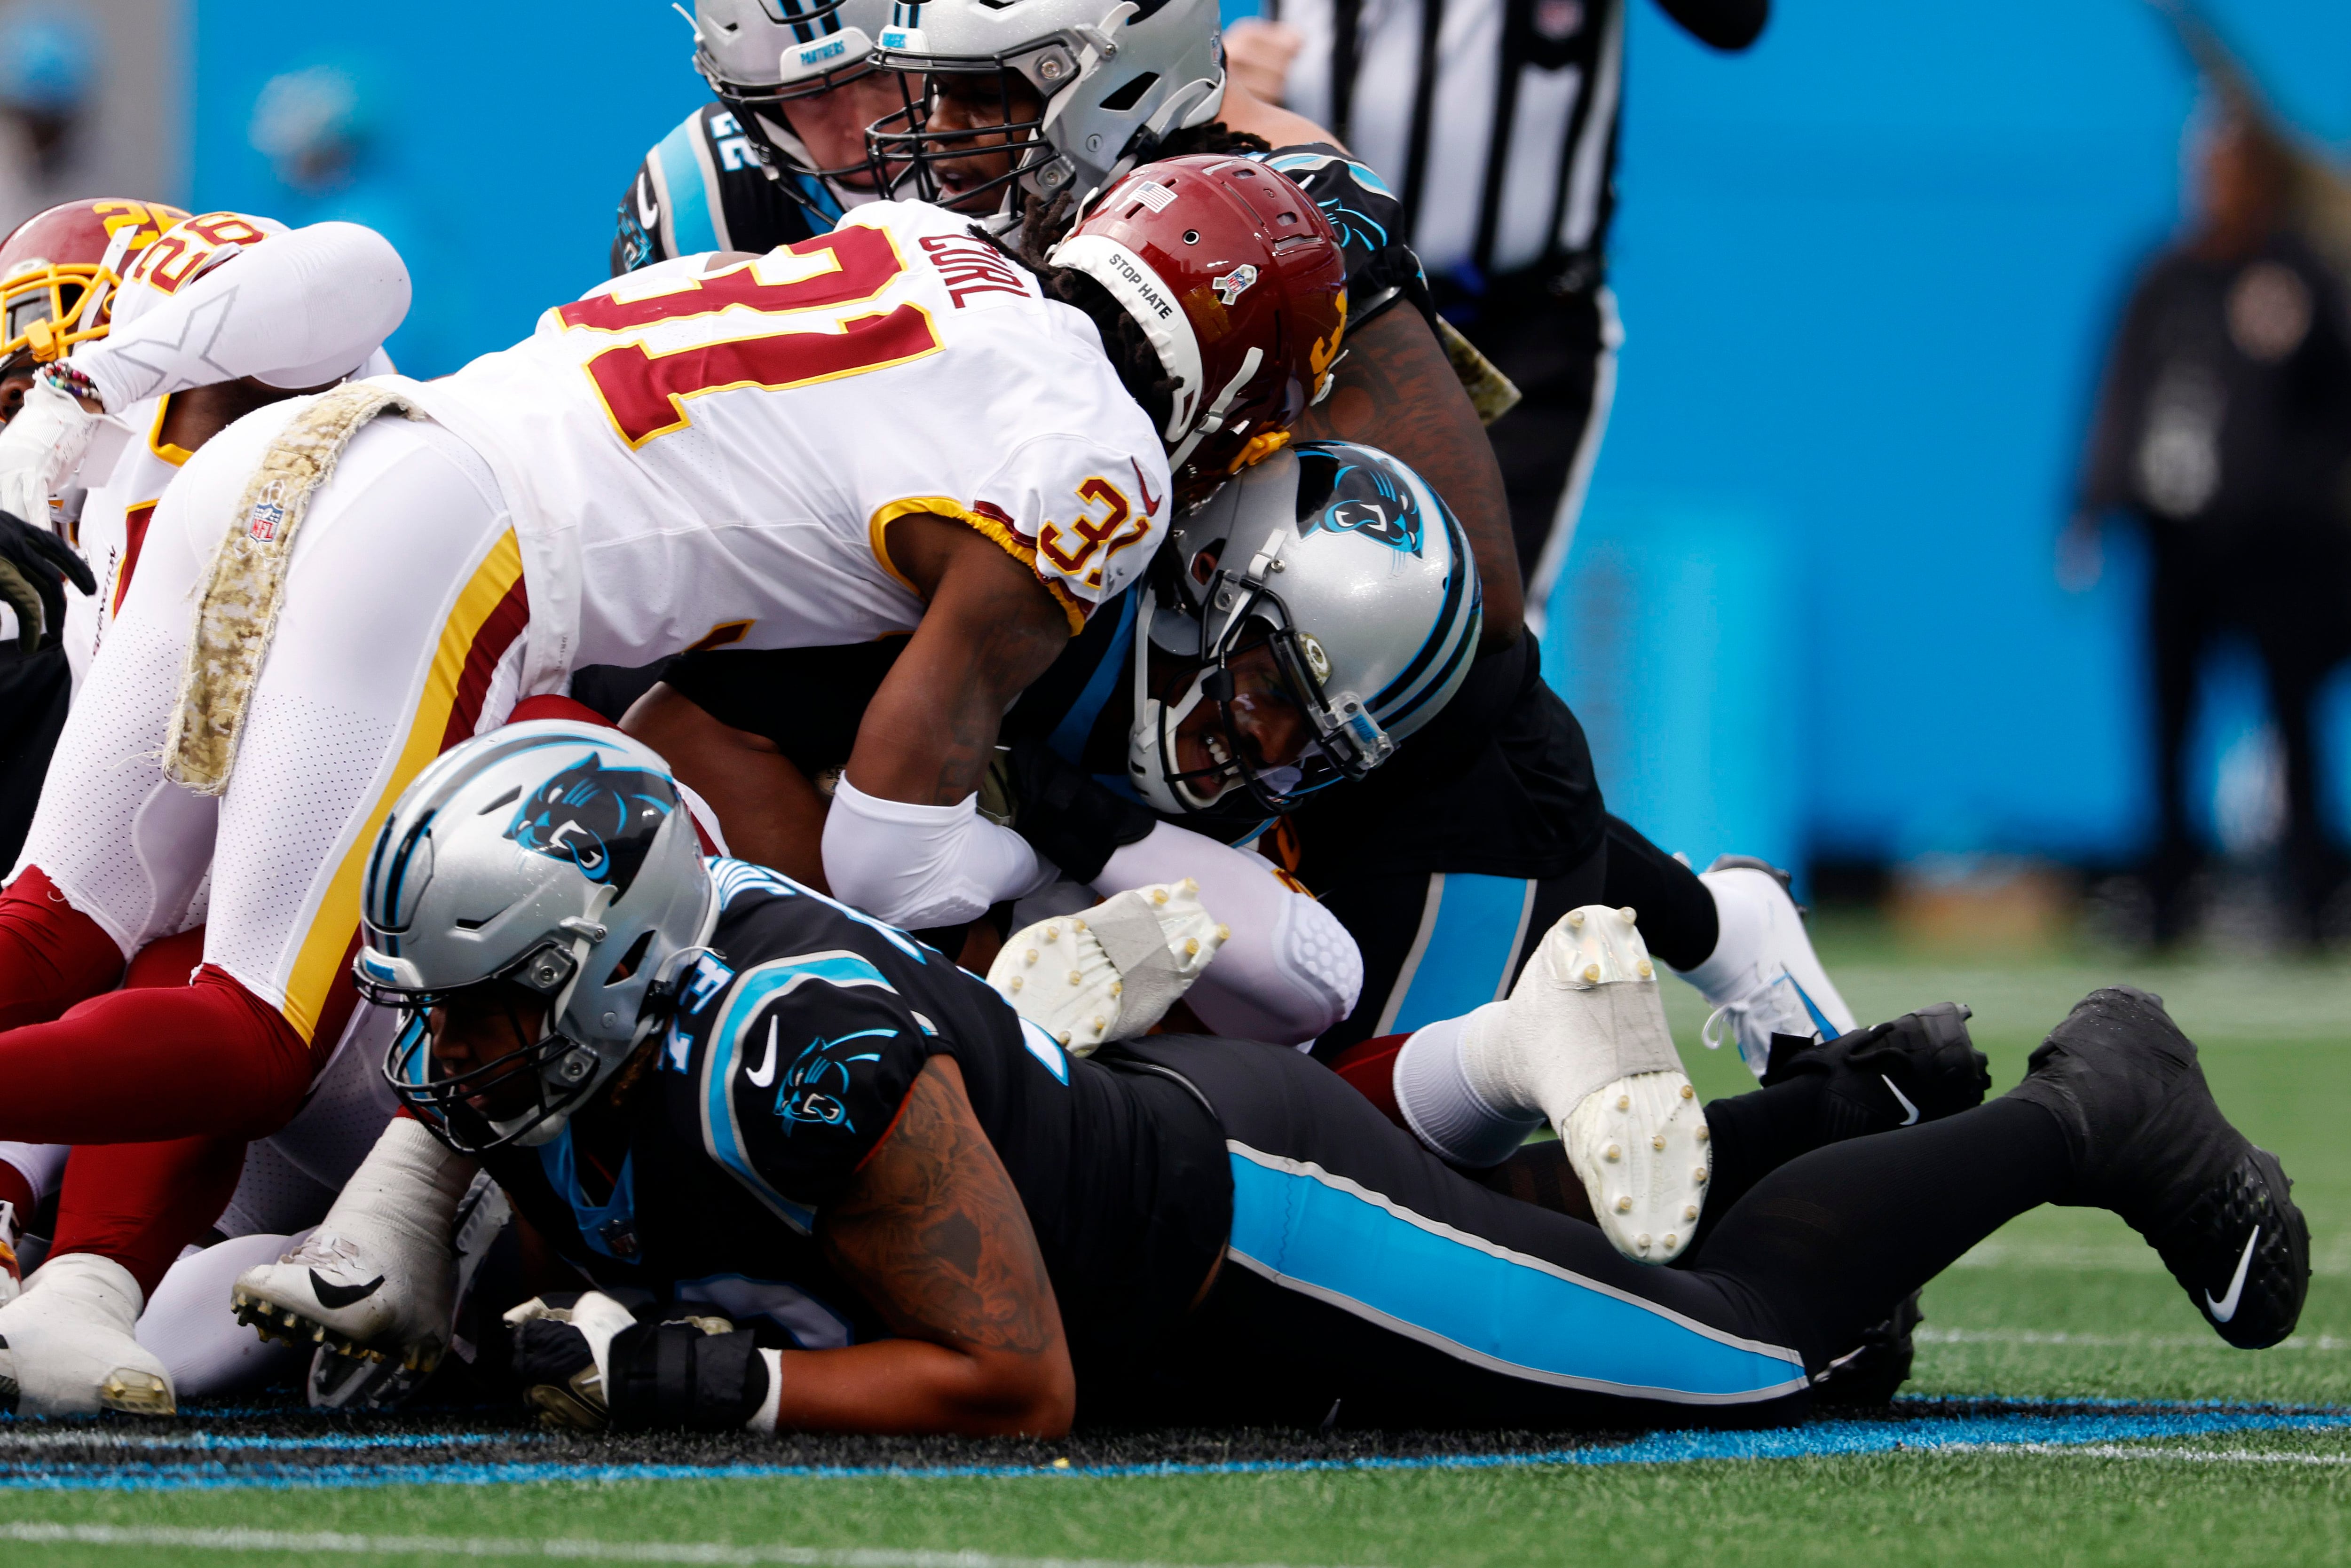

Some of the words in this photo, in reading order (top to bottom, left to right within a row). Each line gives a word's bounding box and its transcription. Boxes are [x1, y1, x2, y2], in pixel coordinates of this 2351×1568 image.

[800, 39, 845, 65] PANTHERS
[131, 211, 270, 297] 26
[918, 234, 1032, 309] CURL
[1109, 253, 1142, 284] STOP
[1137, 283, 1173, 320] HATE
[1227, 276, 1240, 292] NFL
[250, 518, 274, 539] NFL
[1036, 476, 1152, 591] 31
